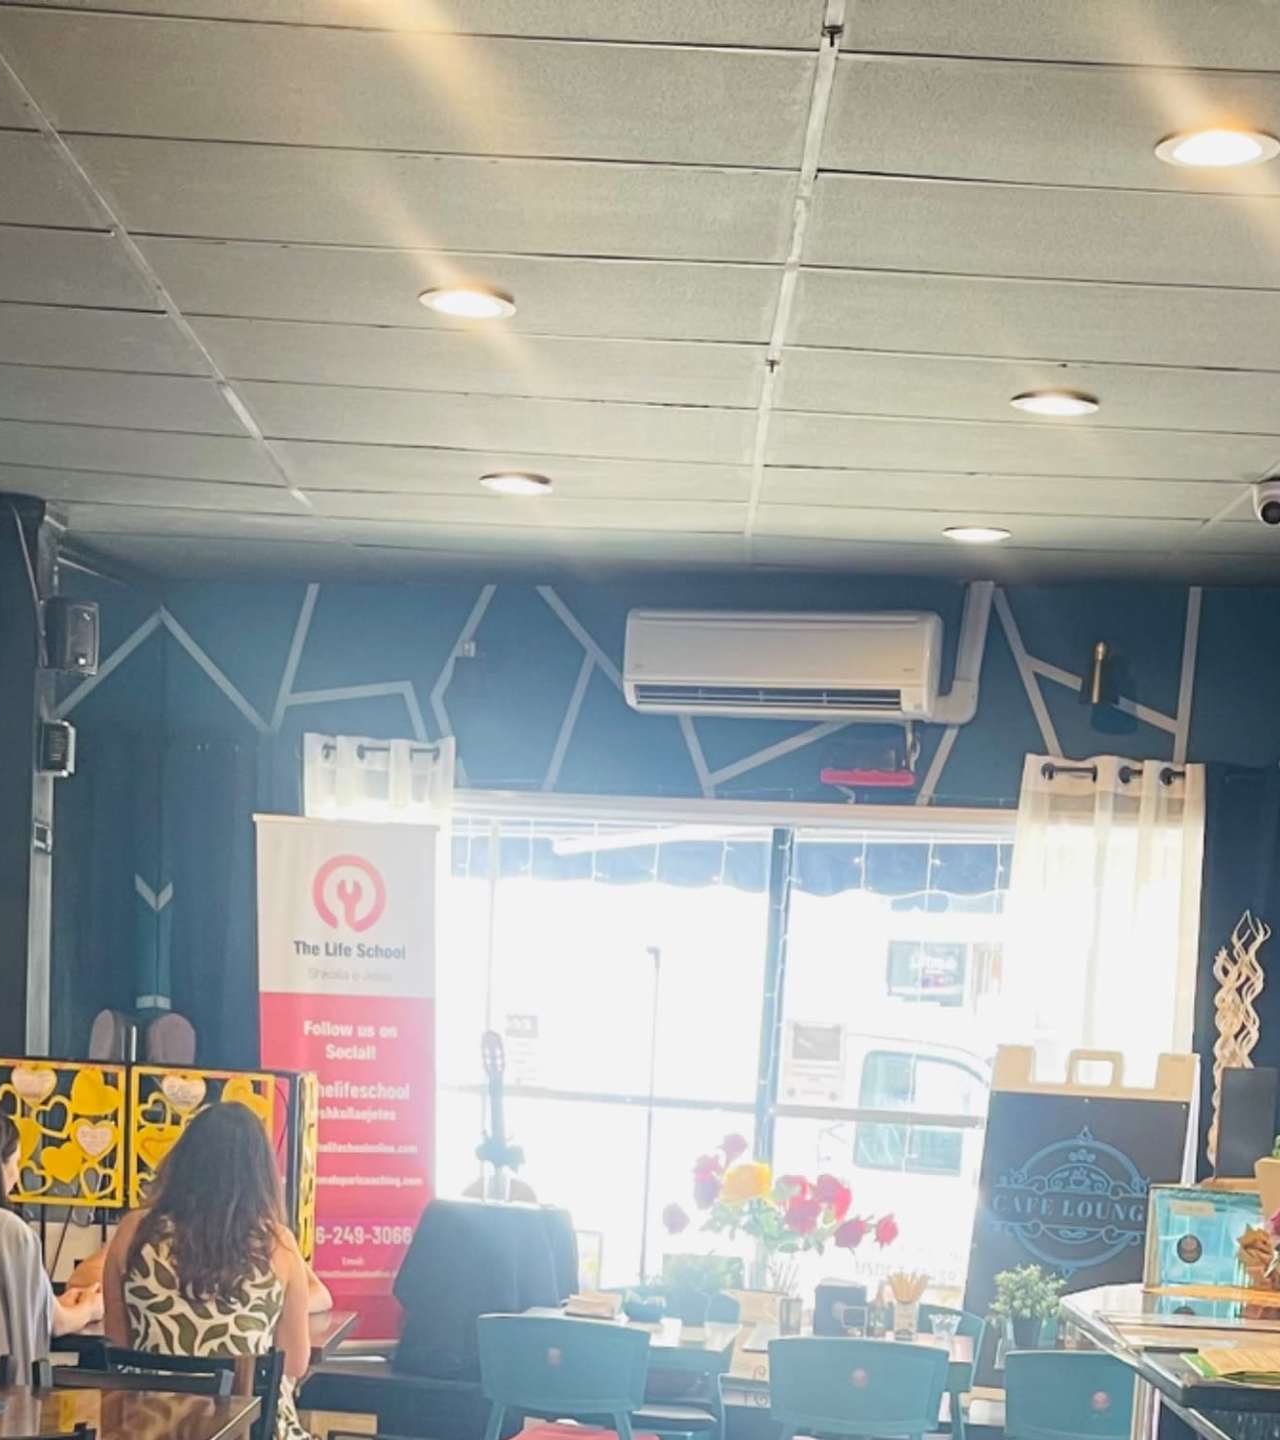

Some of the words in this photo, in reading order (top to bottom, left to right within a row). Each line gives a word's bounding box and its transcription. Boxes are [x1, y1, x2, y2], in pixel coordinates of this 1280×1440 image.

[293, 940, 320, 956] The
[324, 942, 352, 957] Life
[355, 943, 406, 960] School
[303, 1020, 353, 1037] Follow
[357, 1026, 375, 1038] us
[379, 1026, 398, 1038] on
[318, 1081, 410, 1100] helifeschool
[993, 1196, 1055, 1213] CAFE
[1062, 1200, 1144, 1221] LOUNG
[316, 1225, 413, 1245] 6-249-3066
